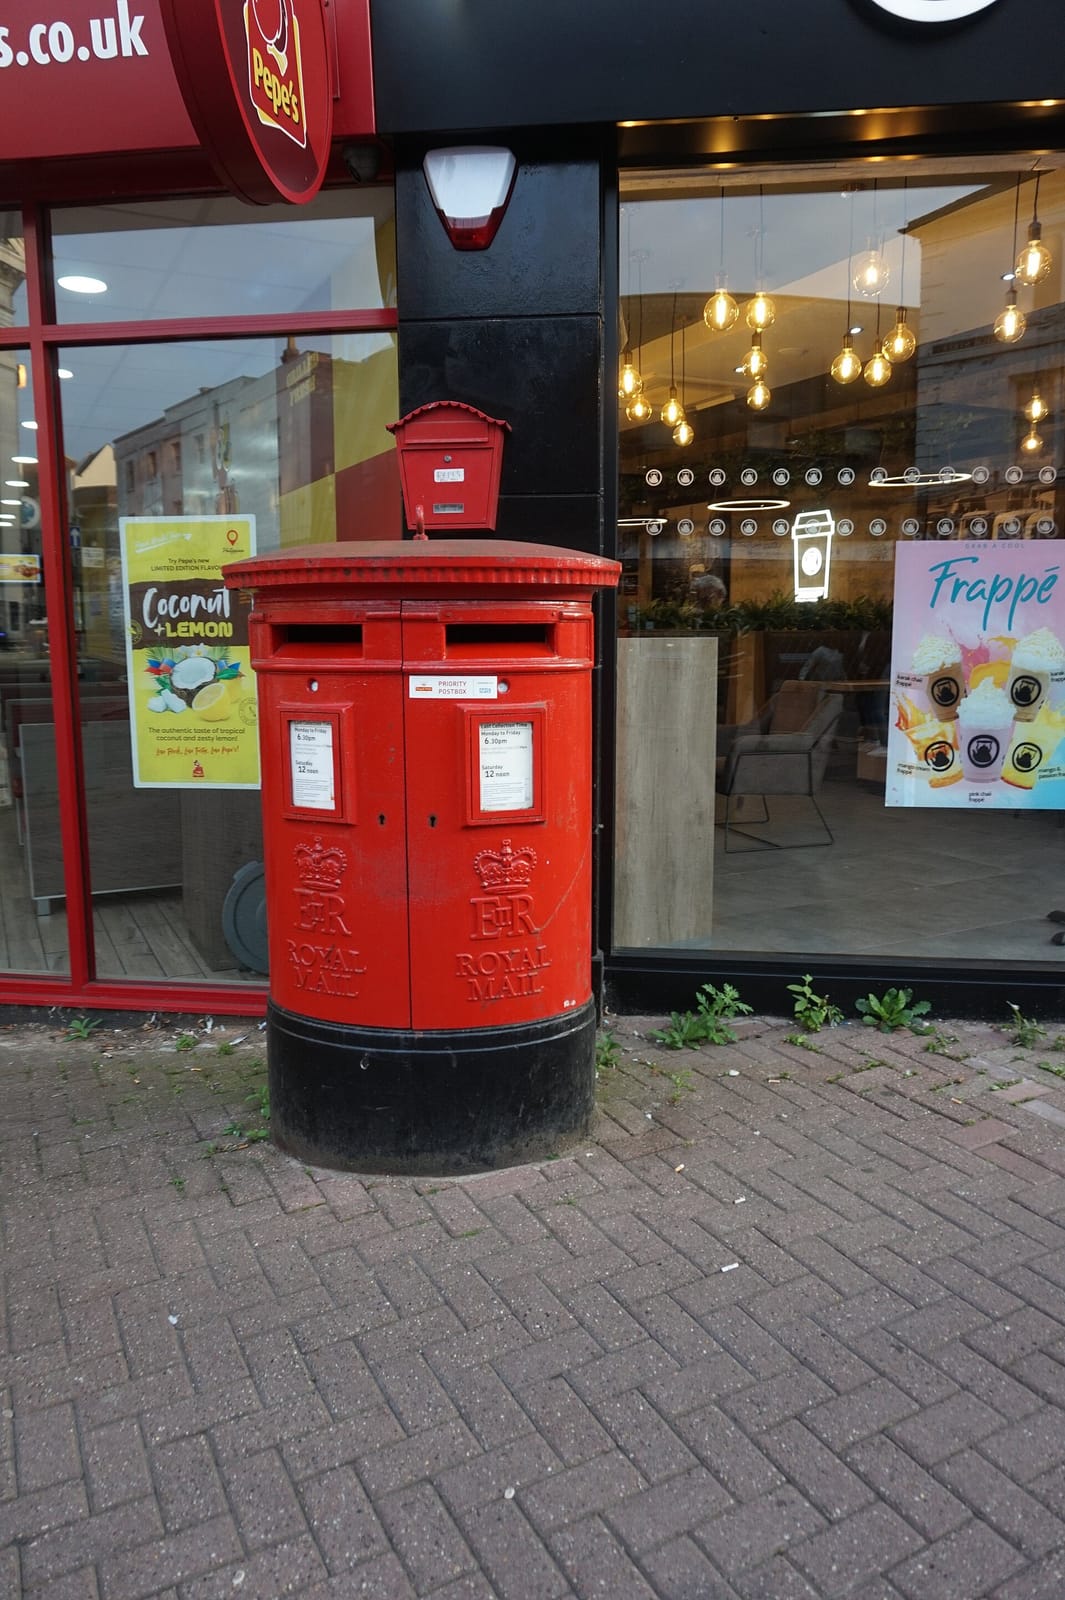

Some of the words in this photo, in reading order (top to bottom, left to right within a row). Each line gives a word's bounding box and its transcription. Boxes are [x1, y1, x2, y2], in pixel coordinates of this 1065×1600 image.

[253, 47, 299, 124] Pepe's
[143, 586, 230, 629] Coconut
[928, 556, 1061, 632] Frappé
[298, 765, 306, 773] 12
[485, 770, 494, 778] 12
[287, 939, 367, 974] ROYAL
[456, 944, 552, 976] ROYAL
[294, 965, 359, 998] MAIL
[467, 971, 544, 1001] MAIL
